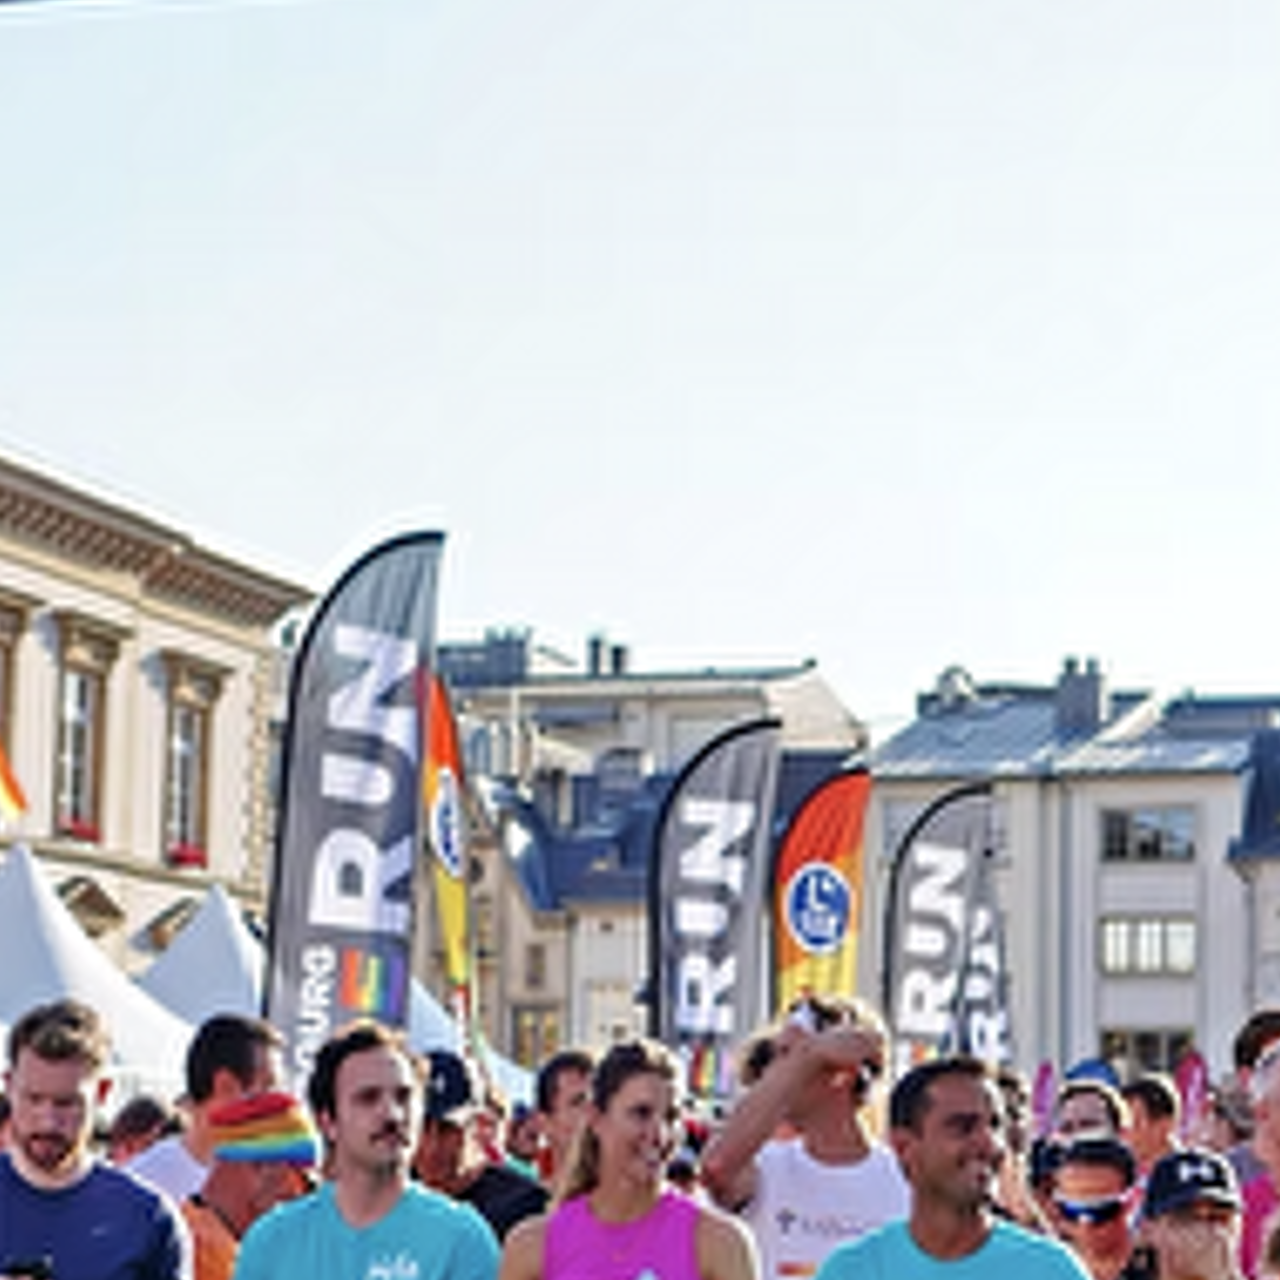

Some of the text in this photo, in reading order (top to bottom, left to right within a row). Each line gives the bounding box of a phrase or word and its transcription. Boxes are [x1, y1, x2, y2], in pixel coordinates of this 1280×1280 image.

[308, 624, 418, 934] RUN
[673, 798, 755, 1034] RUN
[897, 842, 970, 1038] RUN
